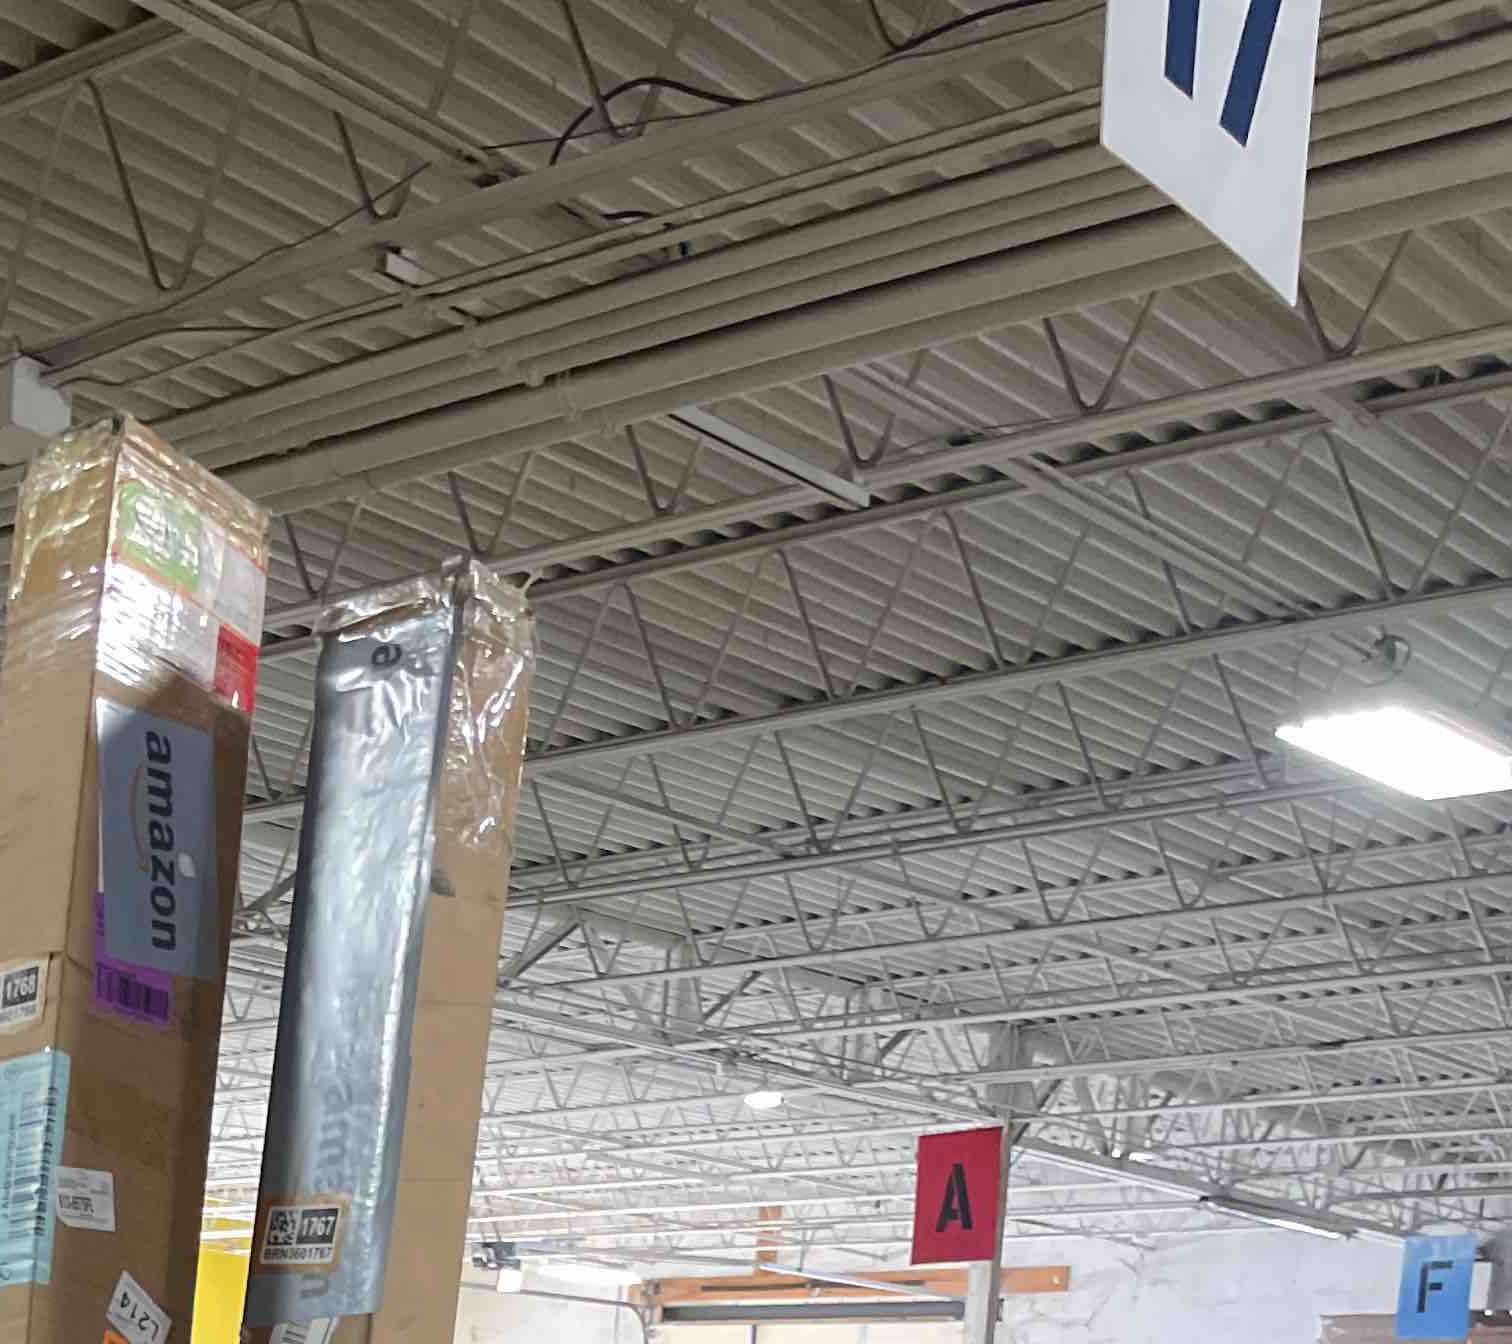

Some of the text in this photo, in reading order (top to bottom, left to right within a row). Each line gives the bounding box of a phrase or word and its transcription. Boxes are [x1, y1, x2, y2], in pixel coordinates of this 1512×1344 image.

[144, 729, 178, 953] amazon
[6, 973, 37, 999] 1768
[935, 1162, 974, 1233] A
[301, 1215, 336, 1238] 1767
[1416, 1260, 1454, 1314] F
